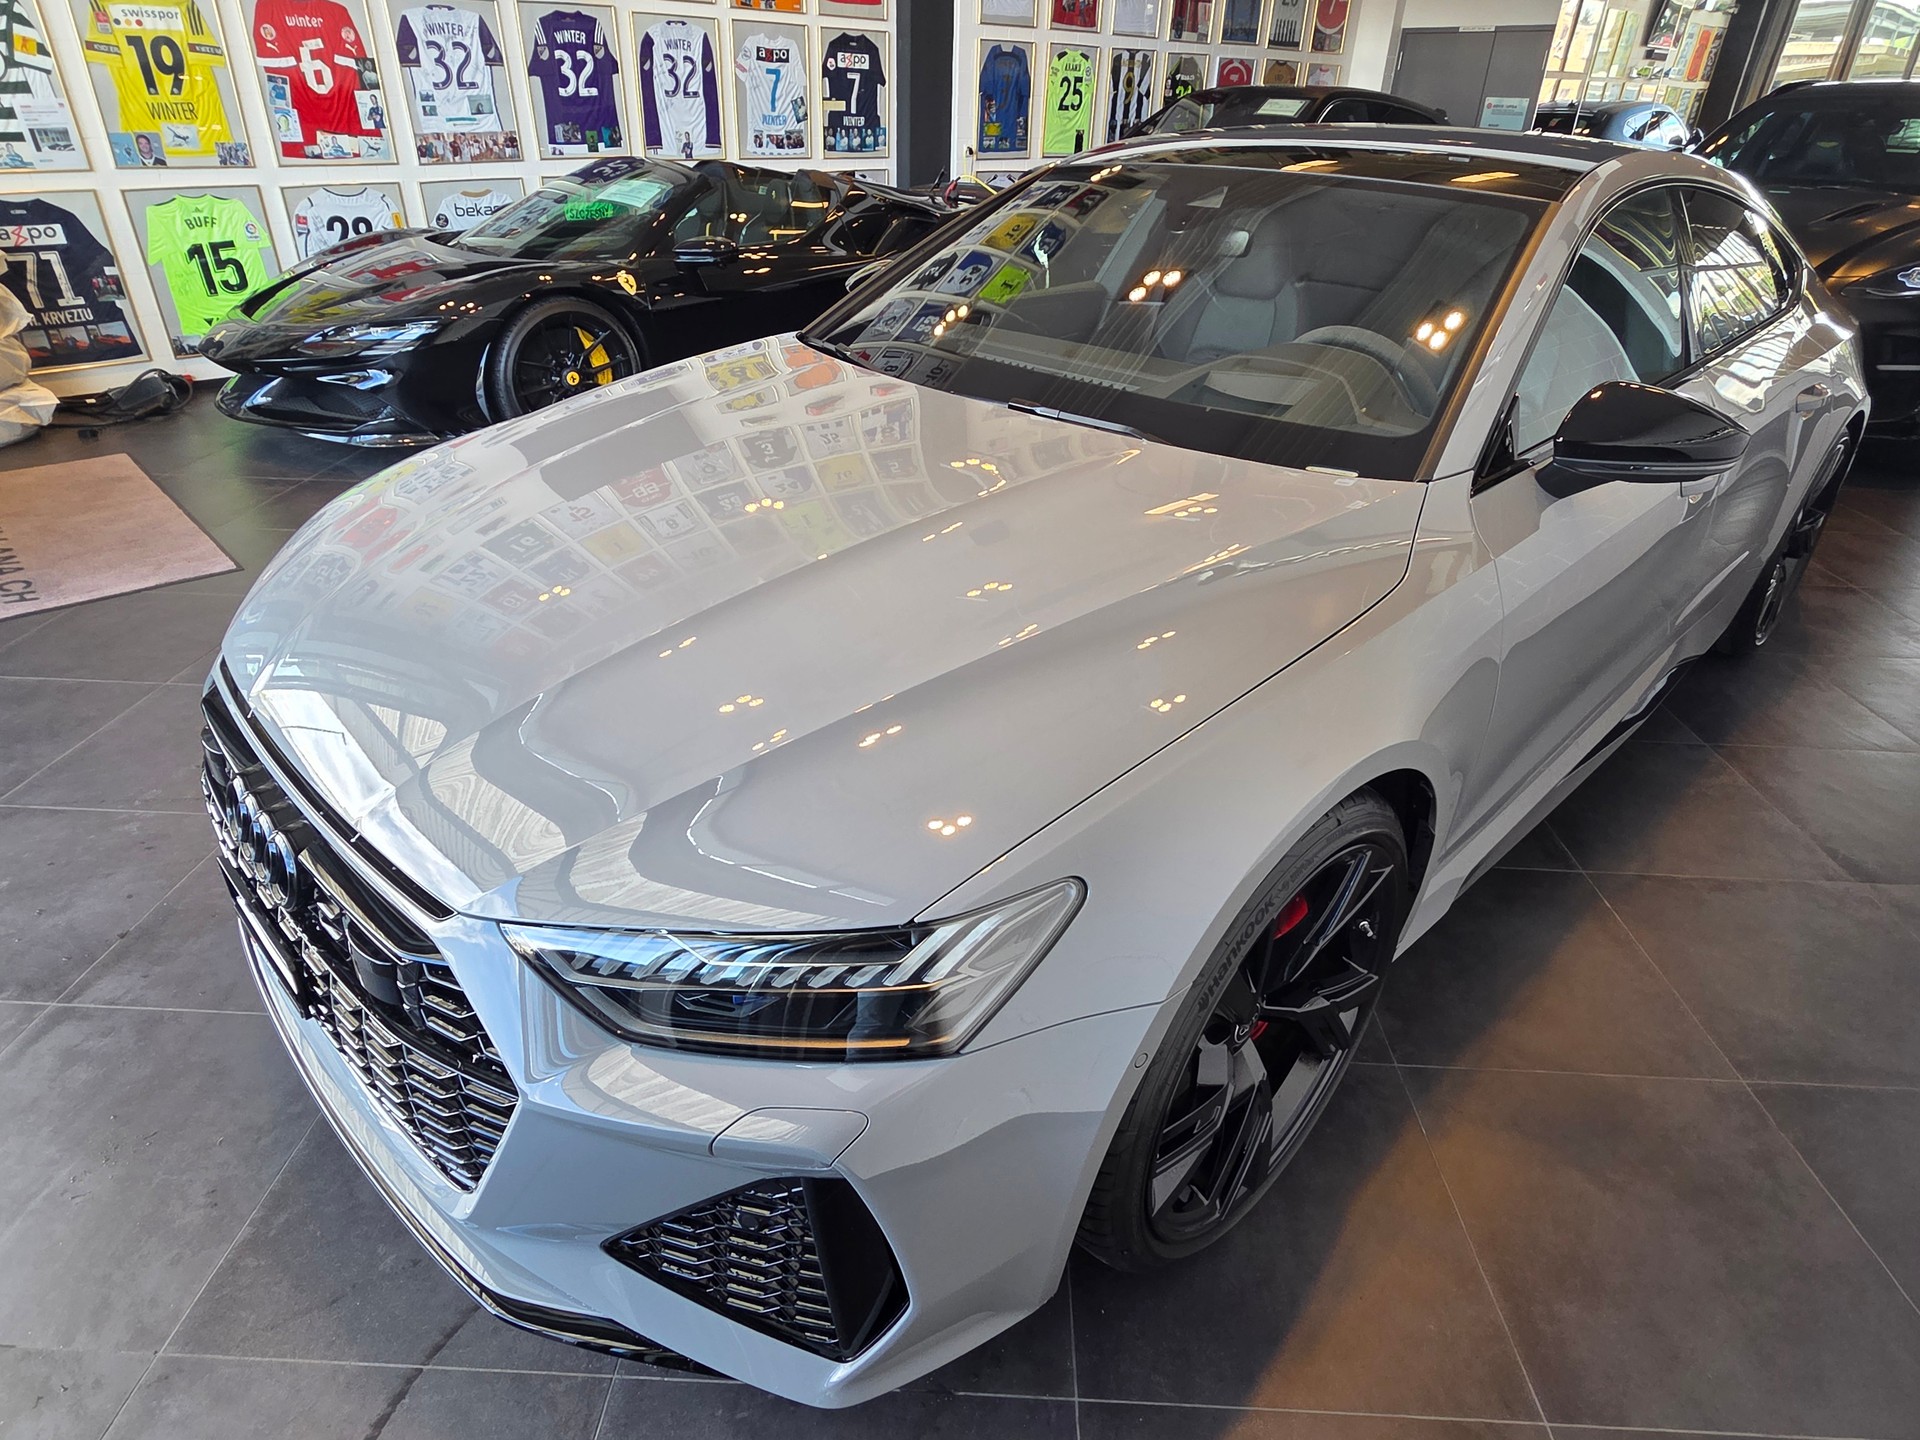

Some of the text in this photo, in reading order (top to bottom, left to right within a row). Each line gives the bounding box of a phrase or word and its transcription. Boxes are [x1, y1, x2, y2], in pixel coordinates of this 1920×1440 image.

[285, 14, 324, 28] winter
[427, 22, 464, 37] WINTER
[553, 29, 586, 45] WINTER
[663, 38, 692, 52] WINTER
[125, 35, 187, 96] 19
[298, 38, 334, 95] 6
[425, 40, 479, 91] 32
[554, 50, 598, 97] 32
[662, 53, 701, 98] 32
[765, 68, 781, 112] 7
[846, 72, 861, 114] 7
[1057, 76, 1083, 111] 25
[146, 102, 198, 121] WINTER
[762, 114, 787, 126] WINTER
[843, 115, 865, 127] WINTER
[184, 215, 218, 231] BUFF
[5, 250, 86, 310] 71
[186, 240, 249, 297] 15
[42, 308, 94, 326] KRYEZIU
